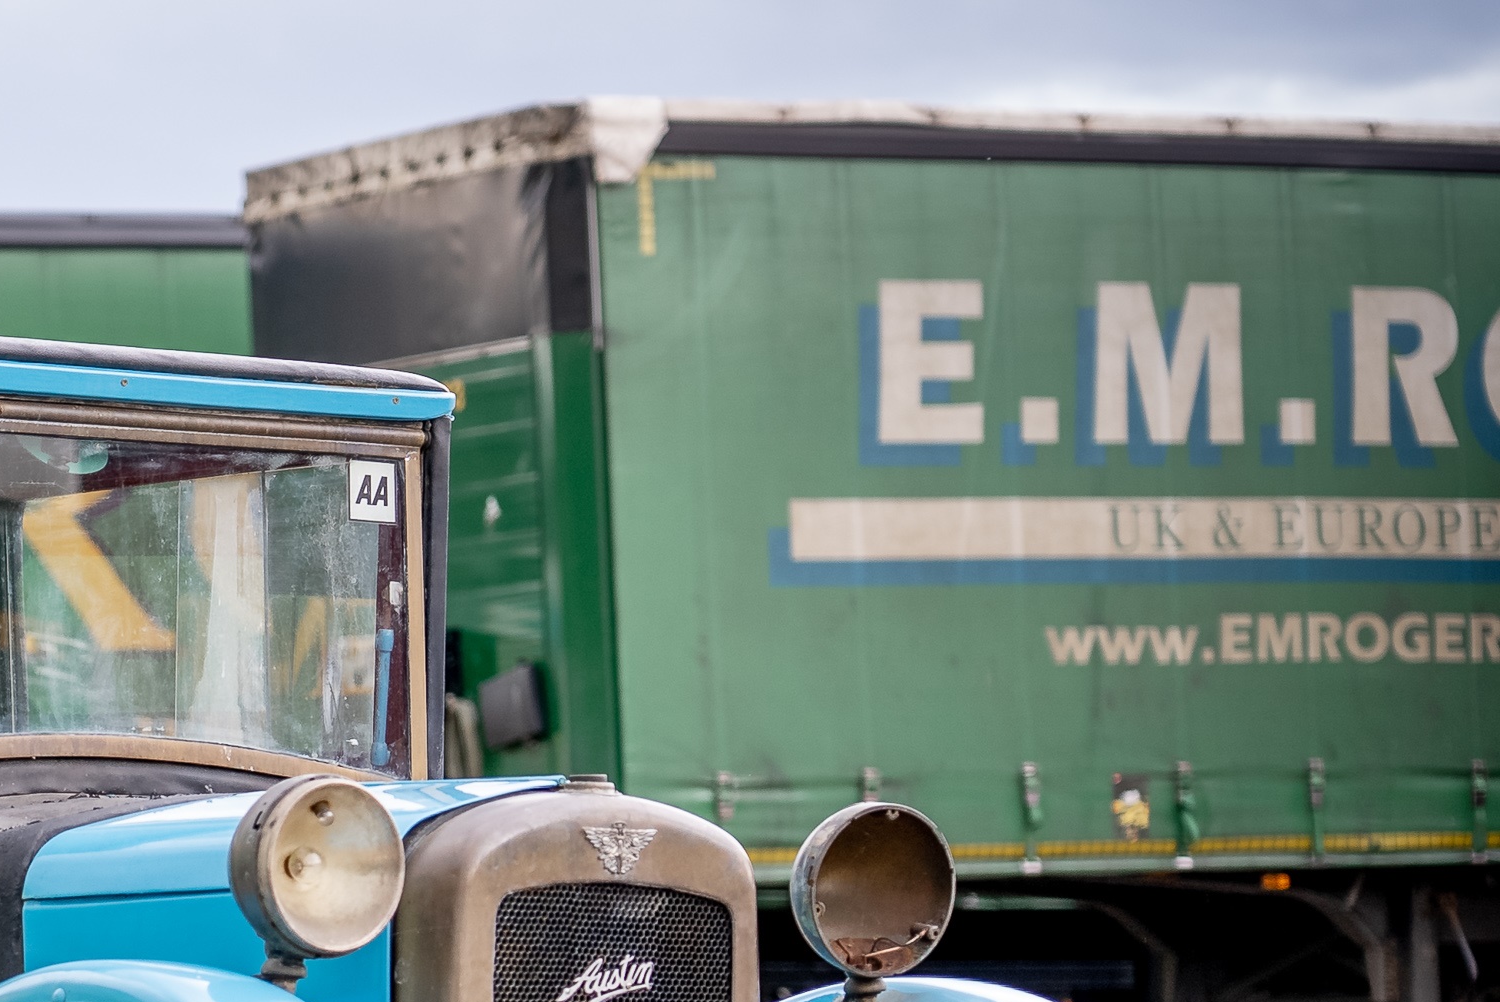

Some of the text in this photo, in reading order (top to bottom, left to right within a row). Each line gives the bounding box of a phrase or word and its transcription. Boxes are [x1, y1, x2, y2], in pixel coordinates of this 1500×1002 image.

[875, 278, 1500, 448] E.M.R
[355, 474, 389, 507] AA
[1108, 502, 1500, 554] UK & EUROPE
[1046, 611, 1500, 666] www.EMROGER
